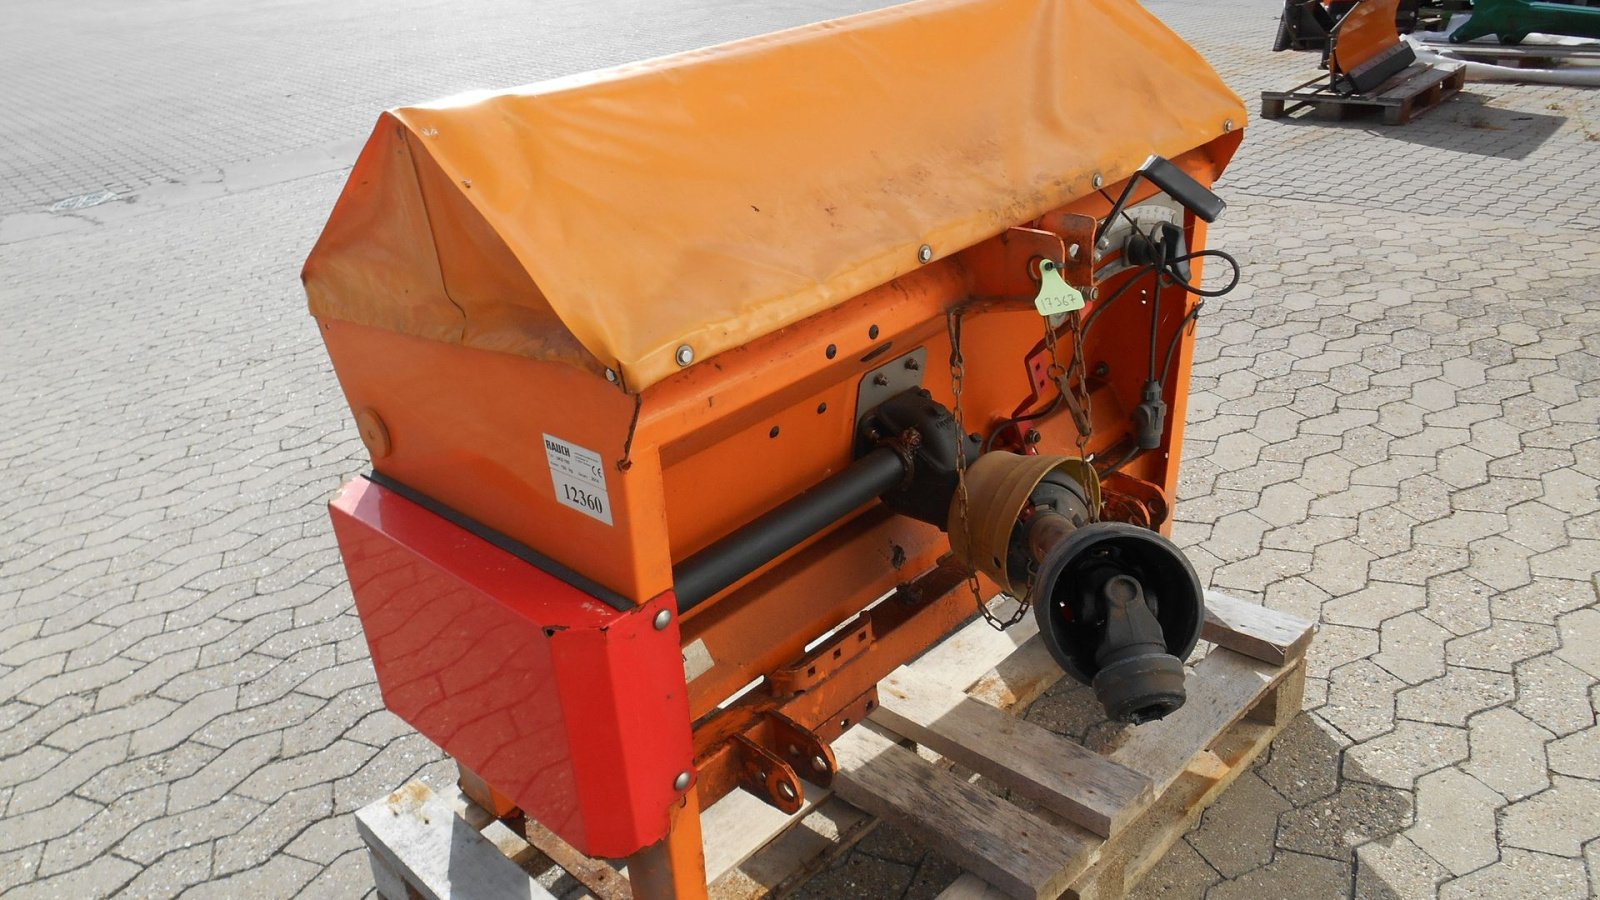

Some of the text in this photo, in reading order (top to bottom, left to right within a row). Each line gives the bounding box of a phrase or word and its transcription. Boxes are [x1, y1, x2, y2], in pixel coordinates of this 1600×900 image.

[1040, 294, 1076, 310] 17367
[545, 440, 571, 457] RAUCH
[563, 483, 603, 514] 12360
